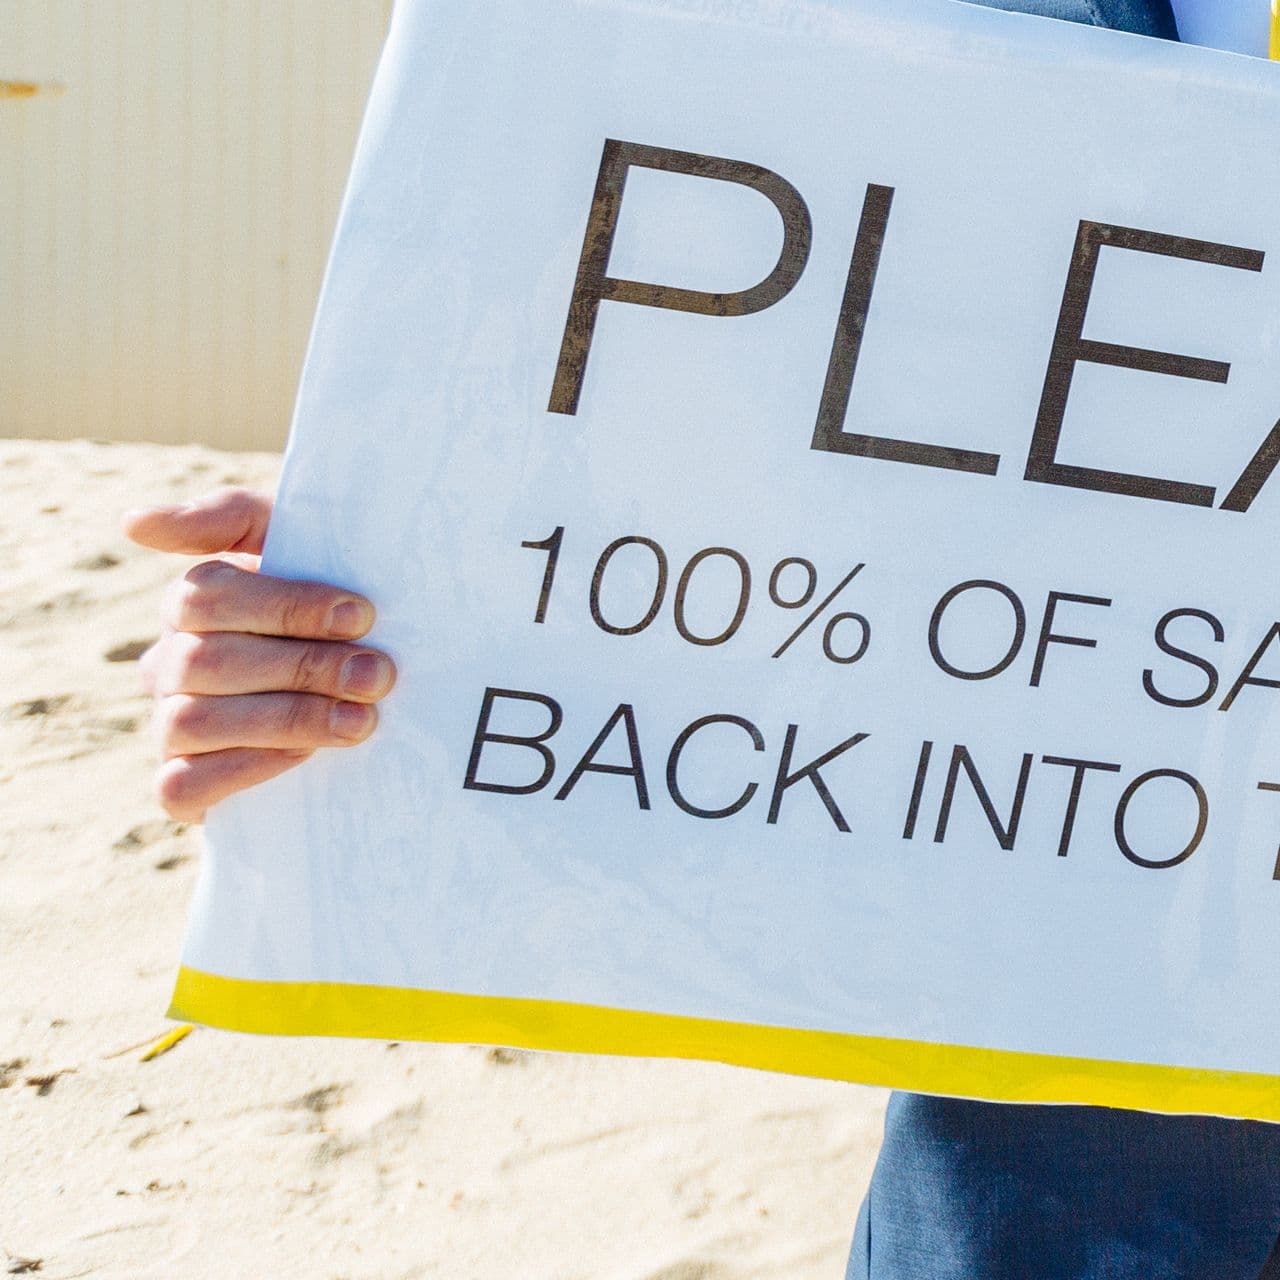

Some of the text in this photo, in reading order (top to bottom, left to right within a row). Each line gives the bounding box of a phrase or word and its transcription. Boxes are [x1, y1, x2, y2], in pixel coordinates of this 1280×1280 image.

[521, 526, 871, 665] 100%
[928, 580, 1112, 688] OF
[463, 687, 871, 838] BACK
[903, 741, 1209, 870] INTO
